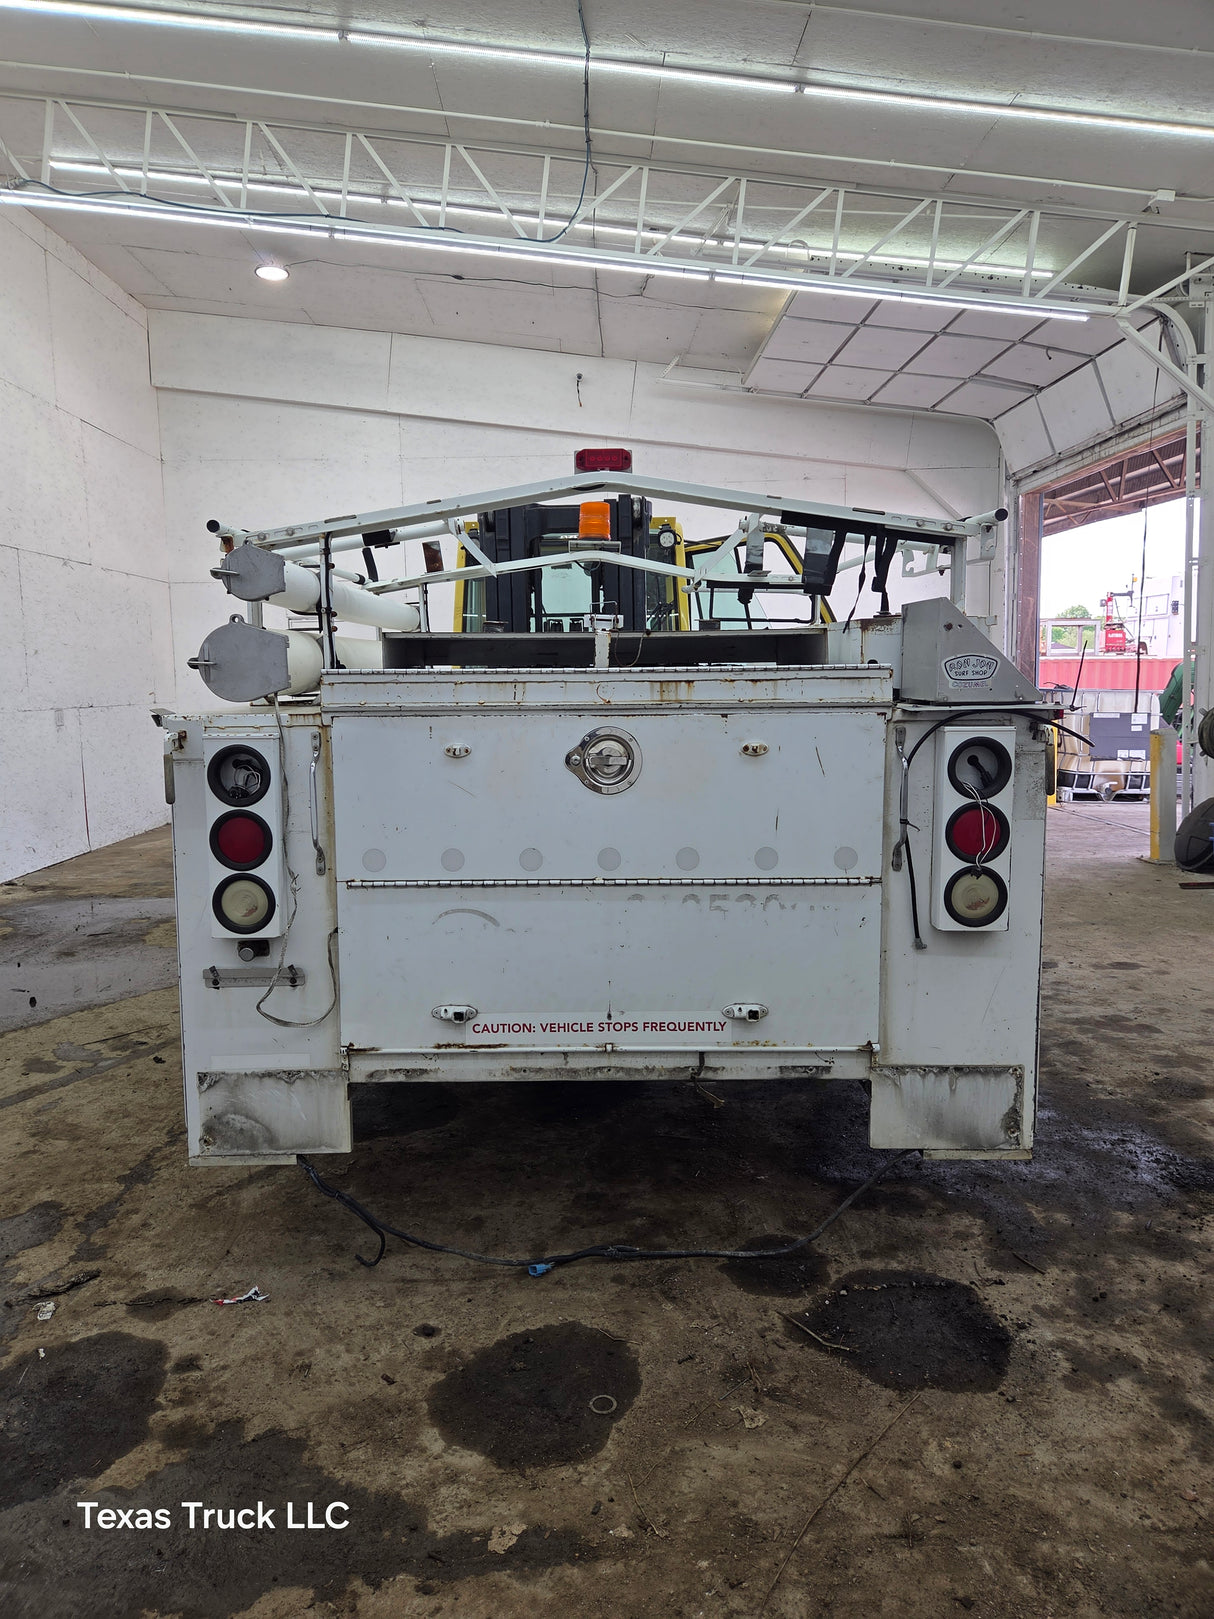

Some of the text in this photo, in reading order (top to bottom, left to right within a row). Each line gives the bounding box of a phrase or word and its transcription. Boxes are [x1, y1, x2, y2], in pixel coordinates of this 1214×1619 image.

[949, 658, 995, 672] RON JON
[472, 1021, 727, 1034] CAUTION: VEHICLE STOPS FREQUENTLY
